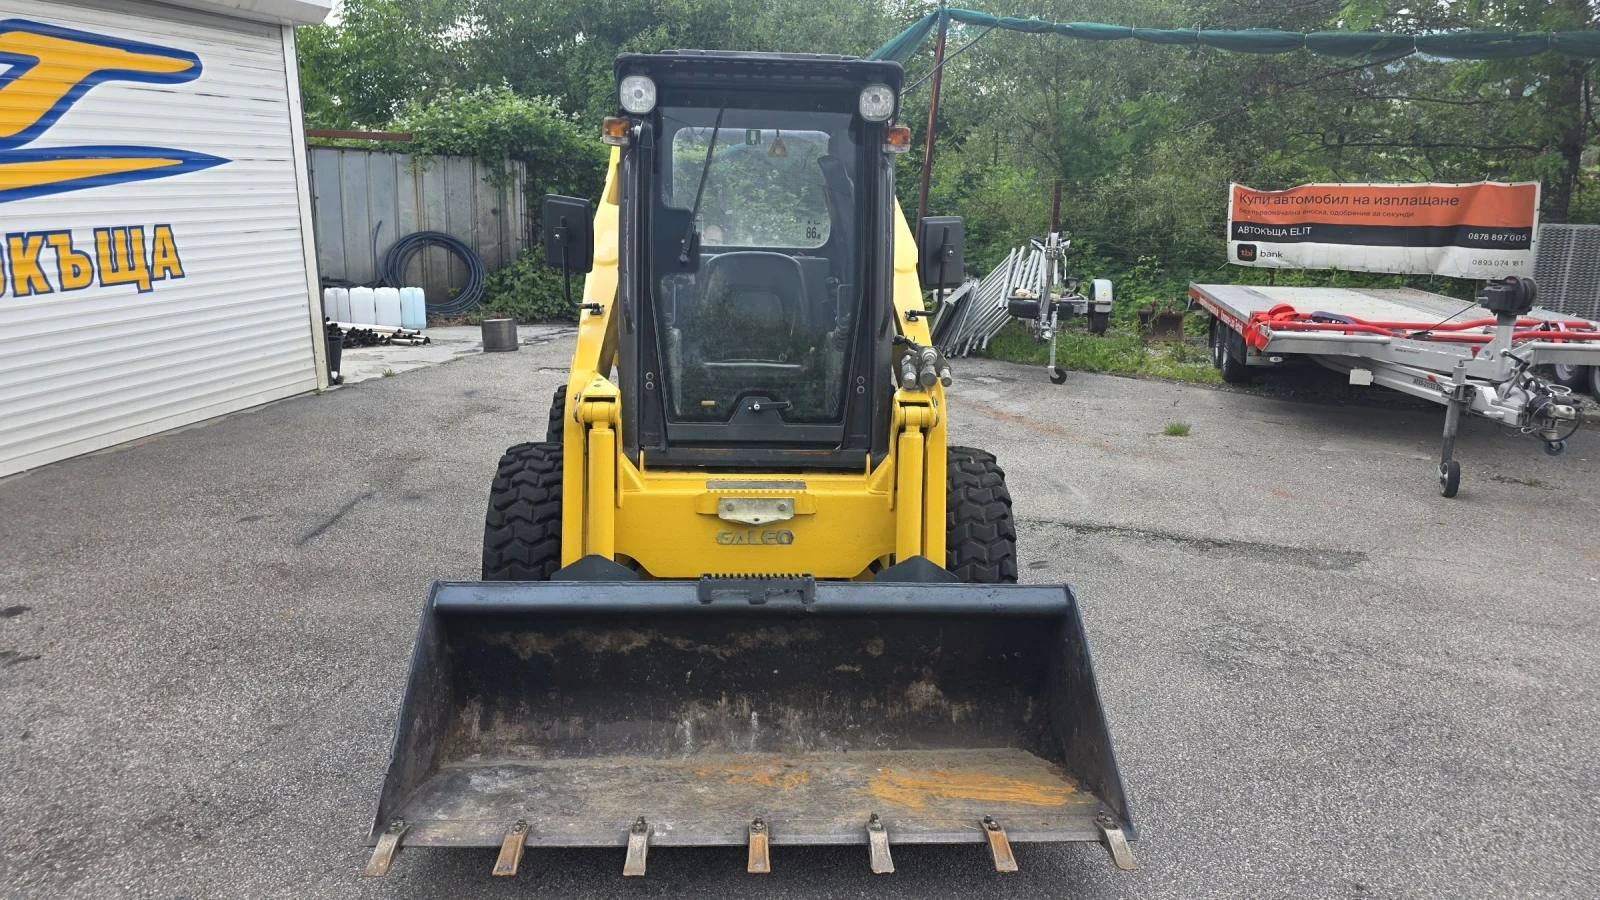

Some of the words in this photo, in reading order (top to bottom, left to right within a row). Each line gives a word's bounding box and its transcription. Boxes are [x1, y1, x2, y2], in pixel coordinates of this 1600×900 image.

[1239, 193, 1271, 206] Купи
[1273, 194, 1349, 205] автомобил
[1352, 196, 1370, 205] на
[1374, 195, 1460, 206] изплащане
[1251, 209, 1301, 217] първоначална
[1330, 209, 1371, 217] одобрение
[1237, 225, 1288, 237] АВТОКЪЩА
[1289, 226, 1312, 236] ELIT
[1468, 232, 1490, 241] 0878
[1491, 233, 1509, 241] 897
[1509, 234, 1527, 242] 005
[1240, 248, 1254, 257] tbi
[1260, 250, 1283, 259] bank
[0, 223, 186, 298] КЪЩА
[716, 529, 795, 545] GALEO
